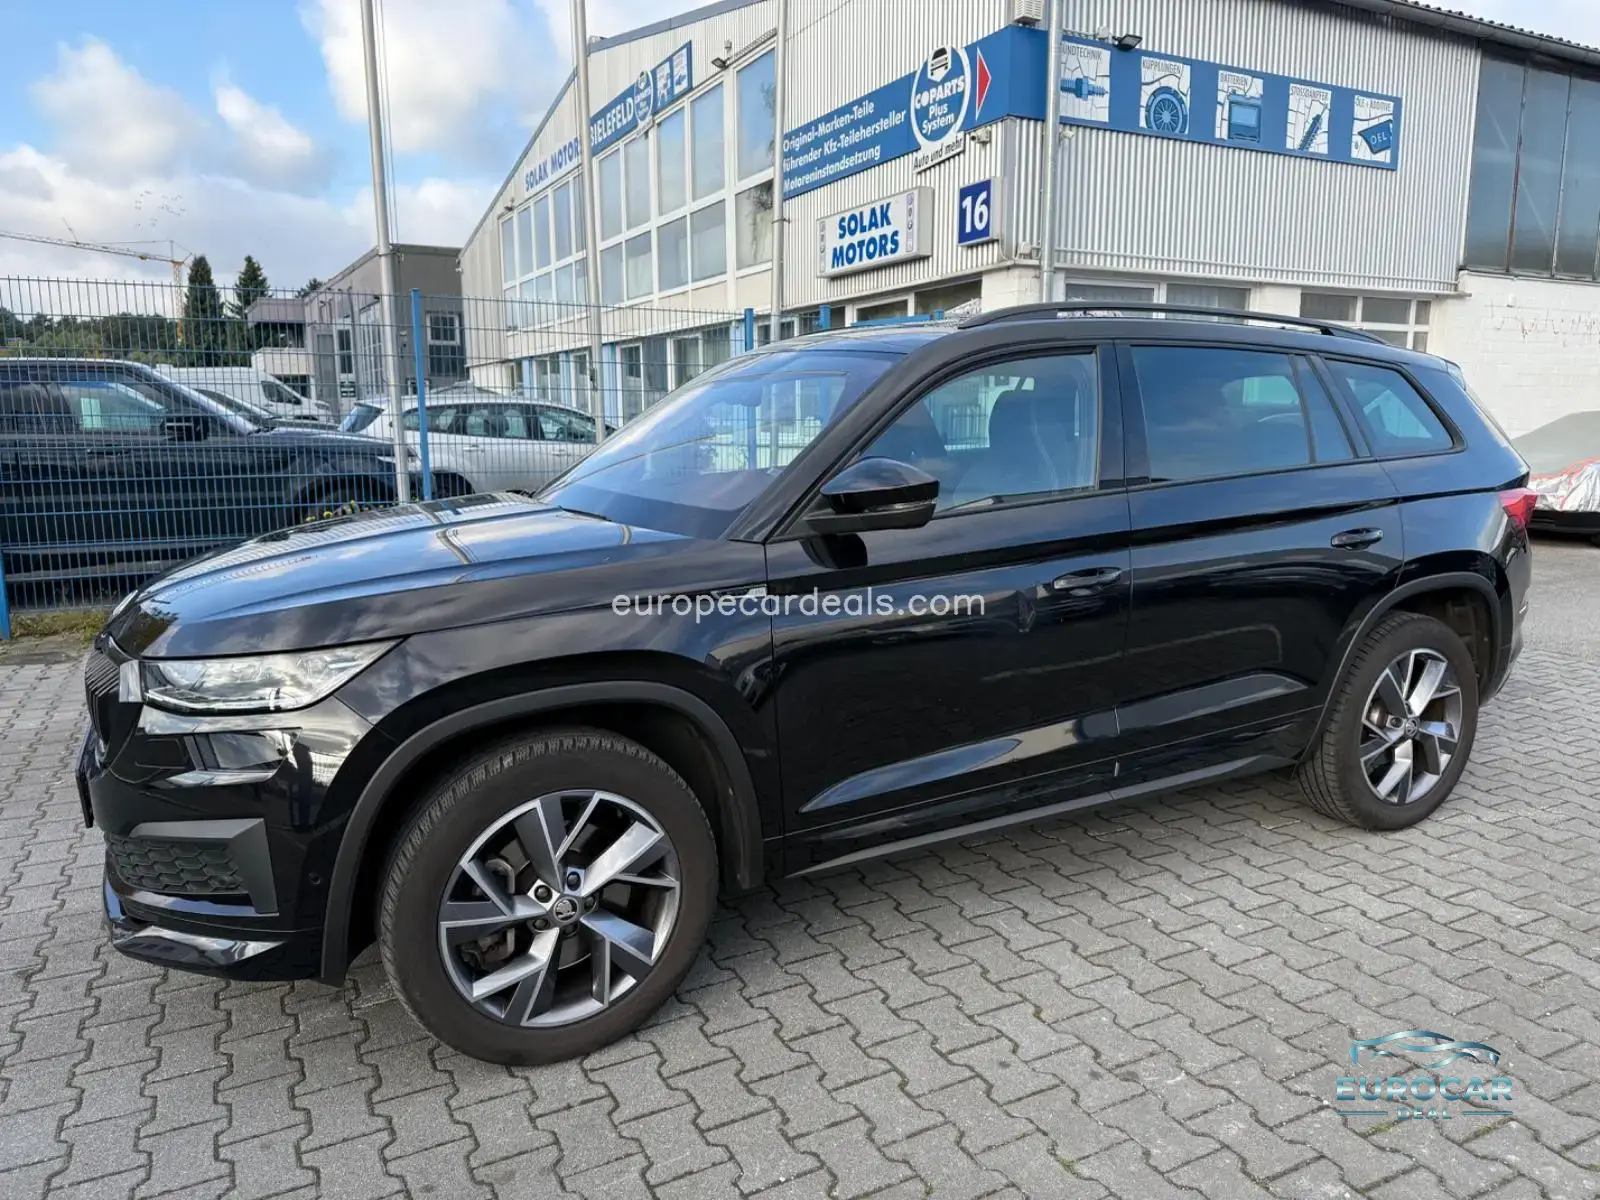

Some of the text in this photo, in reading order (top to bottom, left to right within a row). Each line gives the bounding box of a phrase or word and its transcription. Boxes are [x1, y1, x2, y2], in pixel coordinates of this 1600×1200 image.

[914, 75, 965, 110] COPARTS
[928, 103, 948, 119] Plus
[783, 100, 875, 152] Original-Marken-Teile
[783, 109, 907, 174] führender Kfz-Teilehersteller
[921, 112, 955, 136] System
[1370, 131, 1388, 145] OEL
[524, 137, 582, 193] SOLAK MOTOR
[783, 144, 881, 192] Motoreninstandsetzung
[913, 135, 964, 169] Auto und mehr
[838, 202, 892, 240] SOLAK
[962, 191, 988, 234] 16
[831, 230, 900, 269] MOTORS
